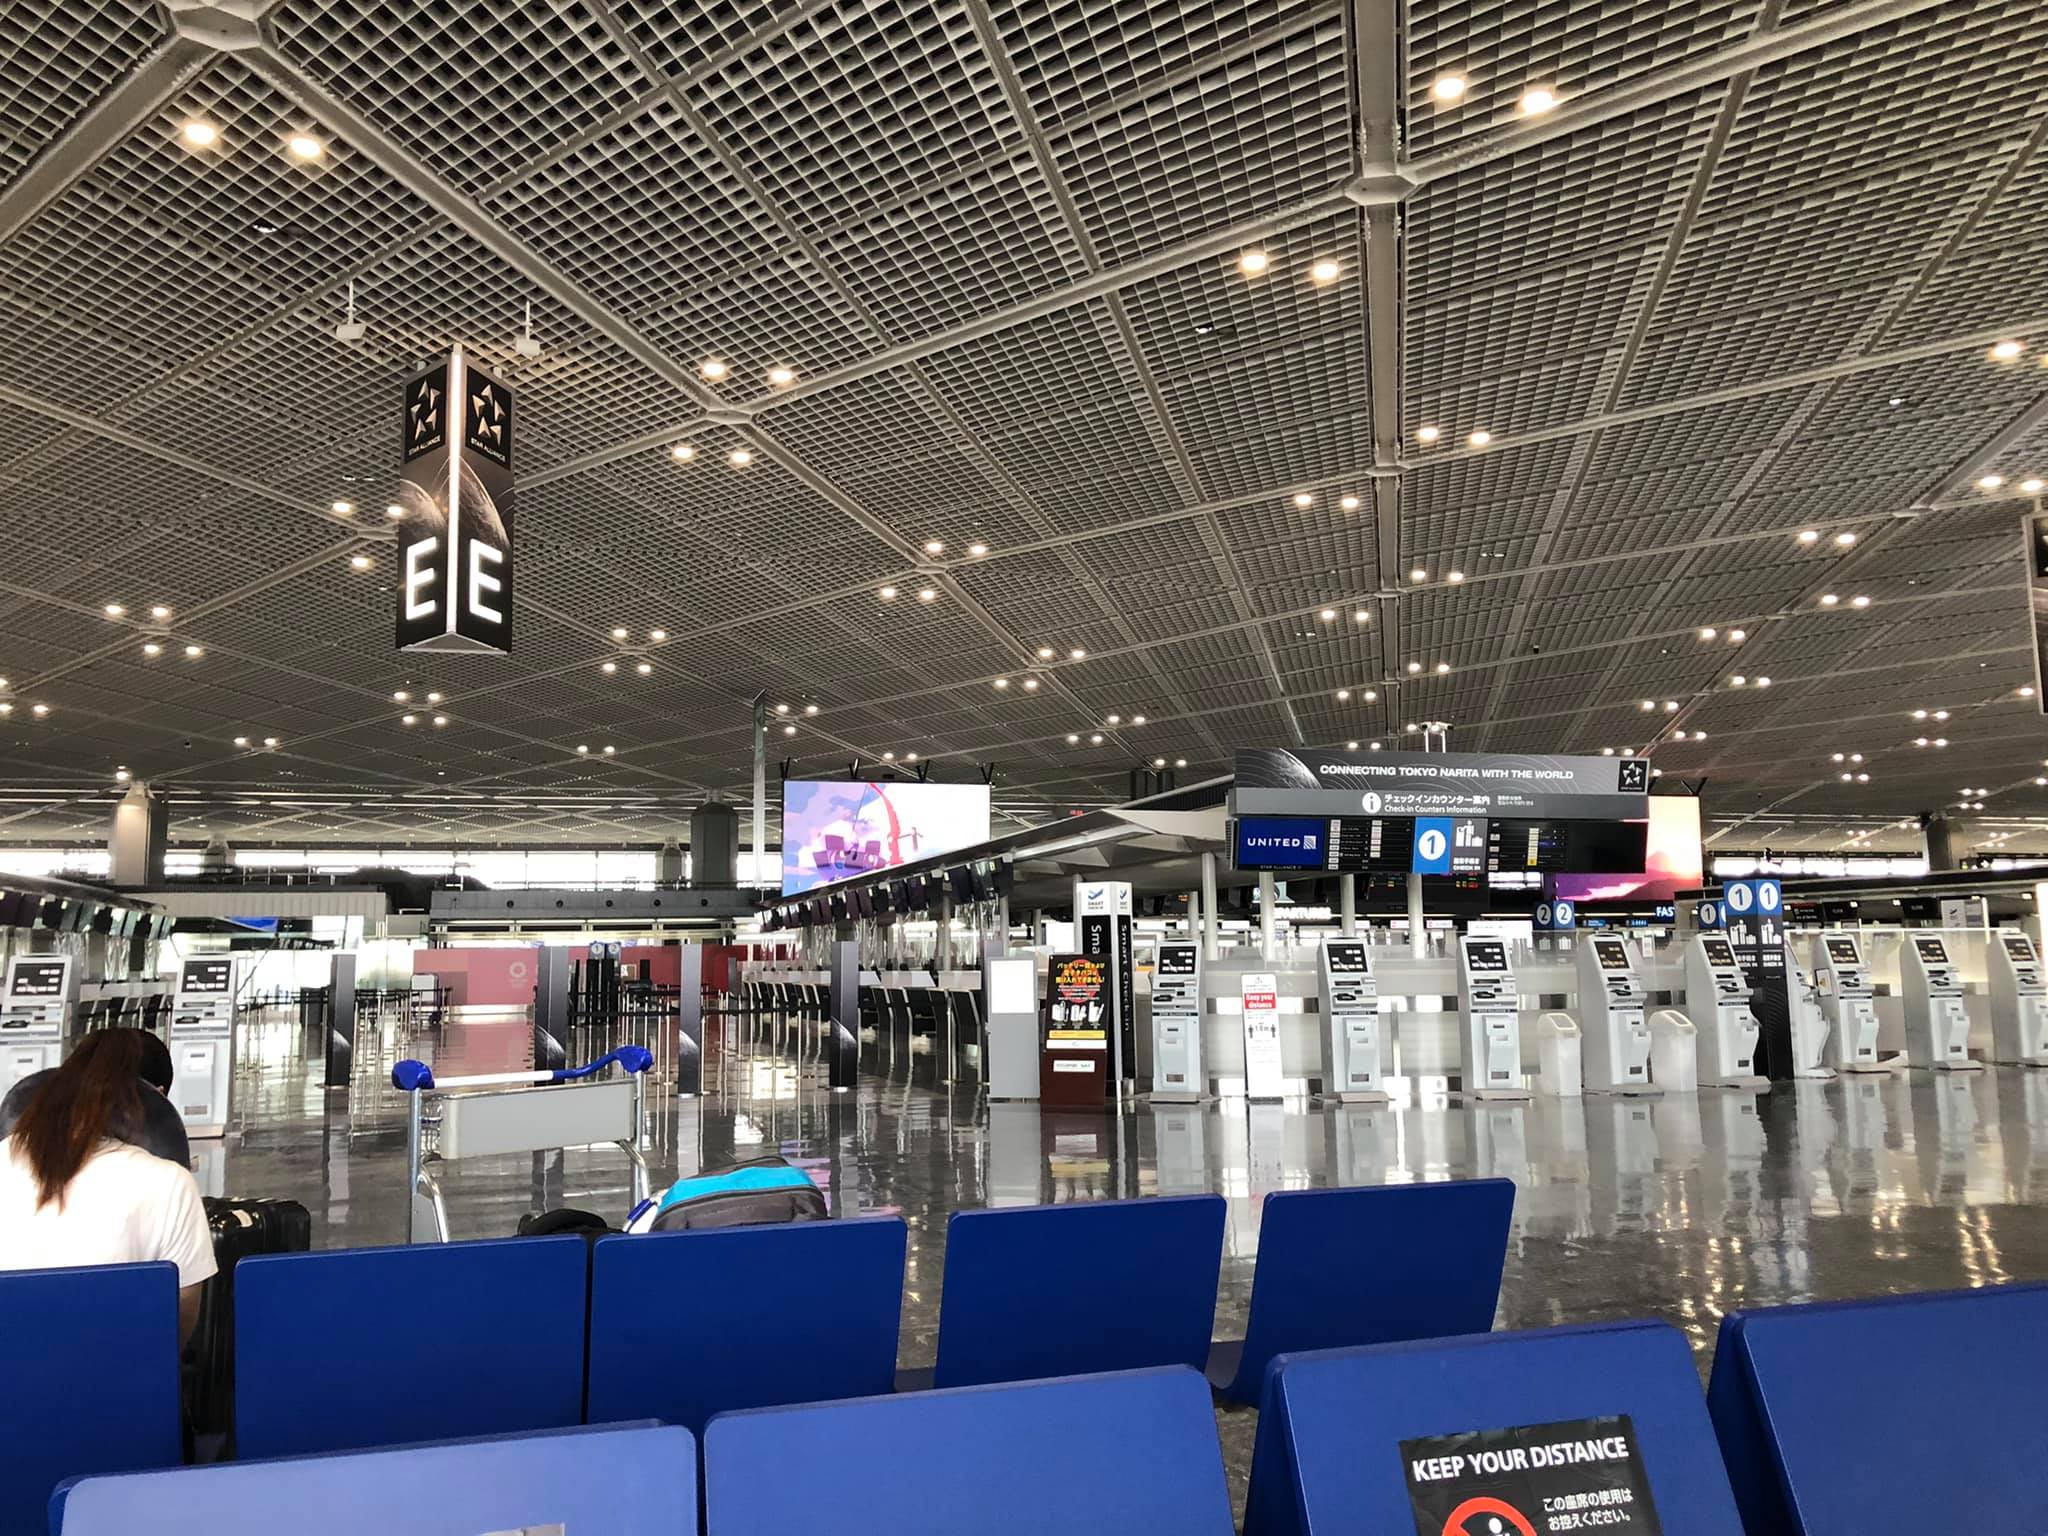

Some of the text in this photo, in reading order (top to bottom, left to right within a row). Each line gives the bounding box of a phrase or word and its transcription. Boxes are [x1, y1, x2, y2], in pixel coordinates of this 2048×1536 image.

[470, 437, 506, 462] STAR ALLIANCE
[406, 536, 437, 621] E
[469, 538, 503, 624] E
[1319, 764, 1574, 780] CONNECTING TOKYO NARITA WITH THE WORLD
[1384, 794, 1491, 805] チェックインカウンター案内
[1384, 804, 1488, 814] Check-in Counters Information
[1247, 838, 1301, 848] UNITED
[1425, 834, 1437, 855] 1
[1735, 888, 1743, 906] 1
[1764, 887, 1771, 905] 1
[1540, 908, 1548, 921] 2
[1560, 908, 1568, 921] 2
[1091, 924, 1102, 954] Sma
[1411, 1436, 1629, 1482] KEEP YOUR DISTANCE
[1542, 1487, 1634, 1512] この座席の使用は
[1547, 1508, 1631, 1531] お控えください。
